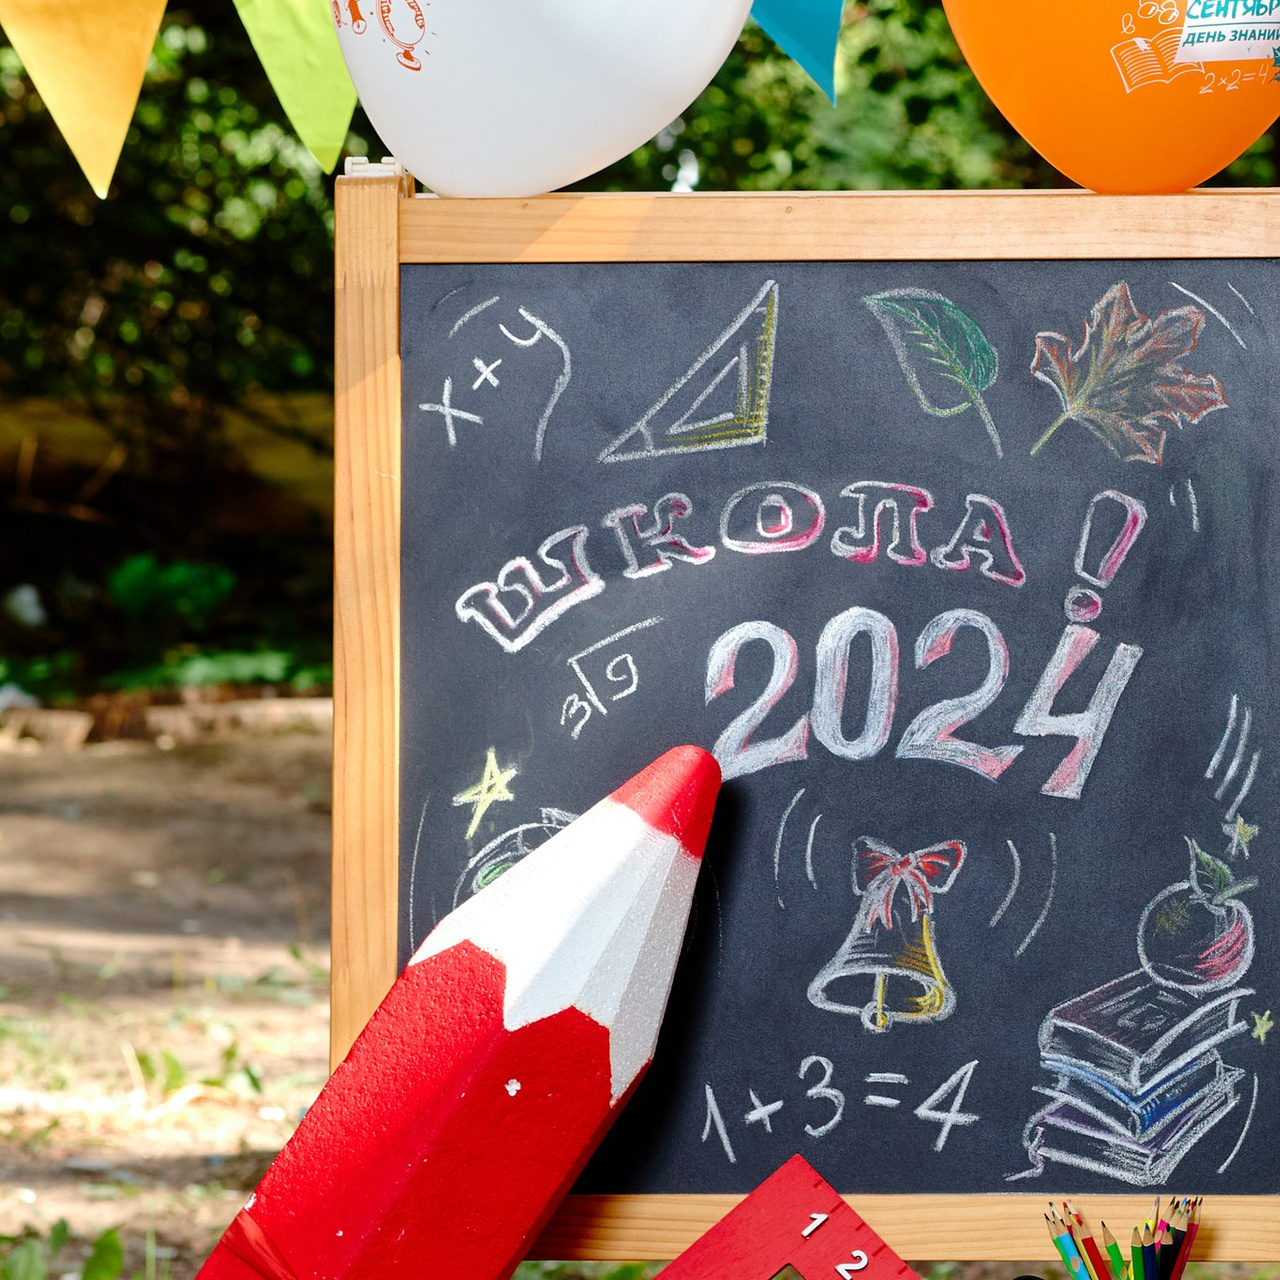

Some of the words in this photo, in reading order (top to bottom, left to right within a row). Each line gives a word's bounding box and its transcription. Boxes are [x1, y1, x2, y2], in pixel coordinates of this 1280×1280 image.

[1183, 29, 1226, 47] ДЕНЬ
[703, 605, 1146, 800] 2024
[800, 1212, 829, 1238] 1
[834, 1249, 869, 1280] 2
